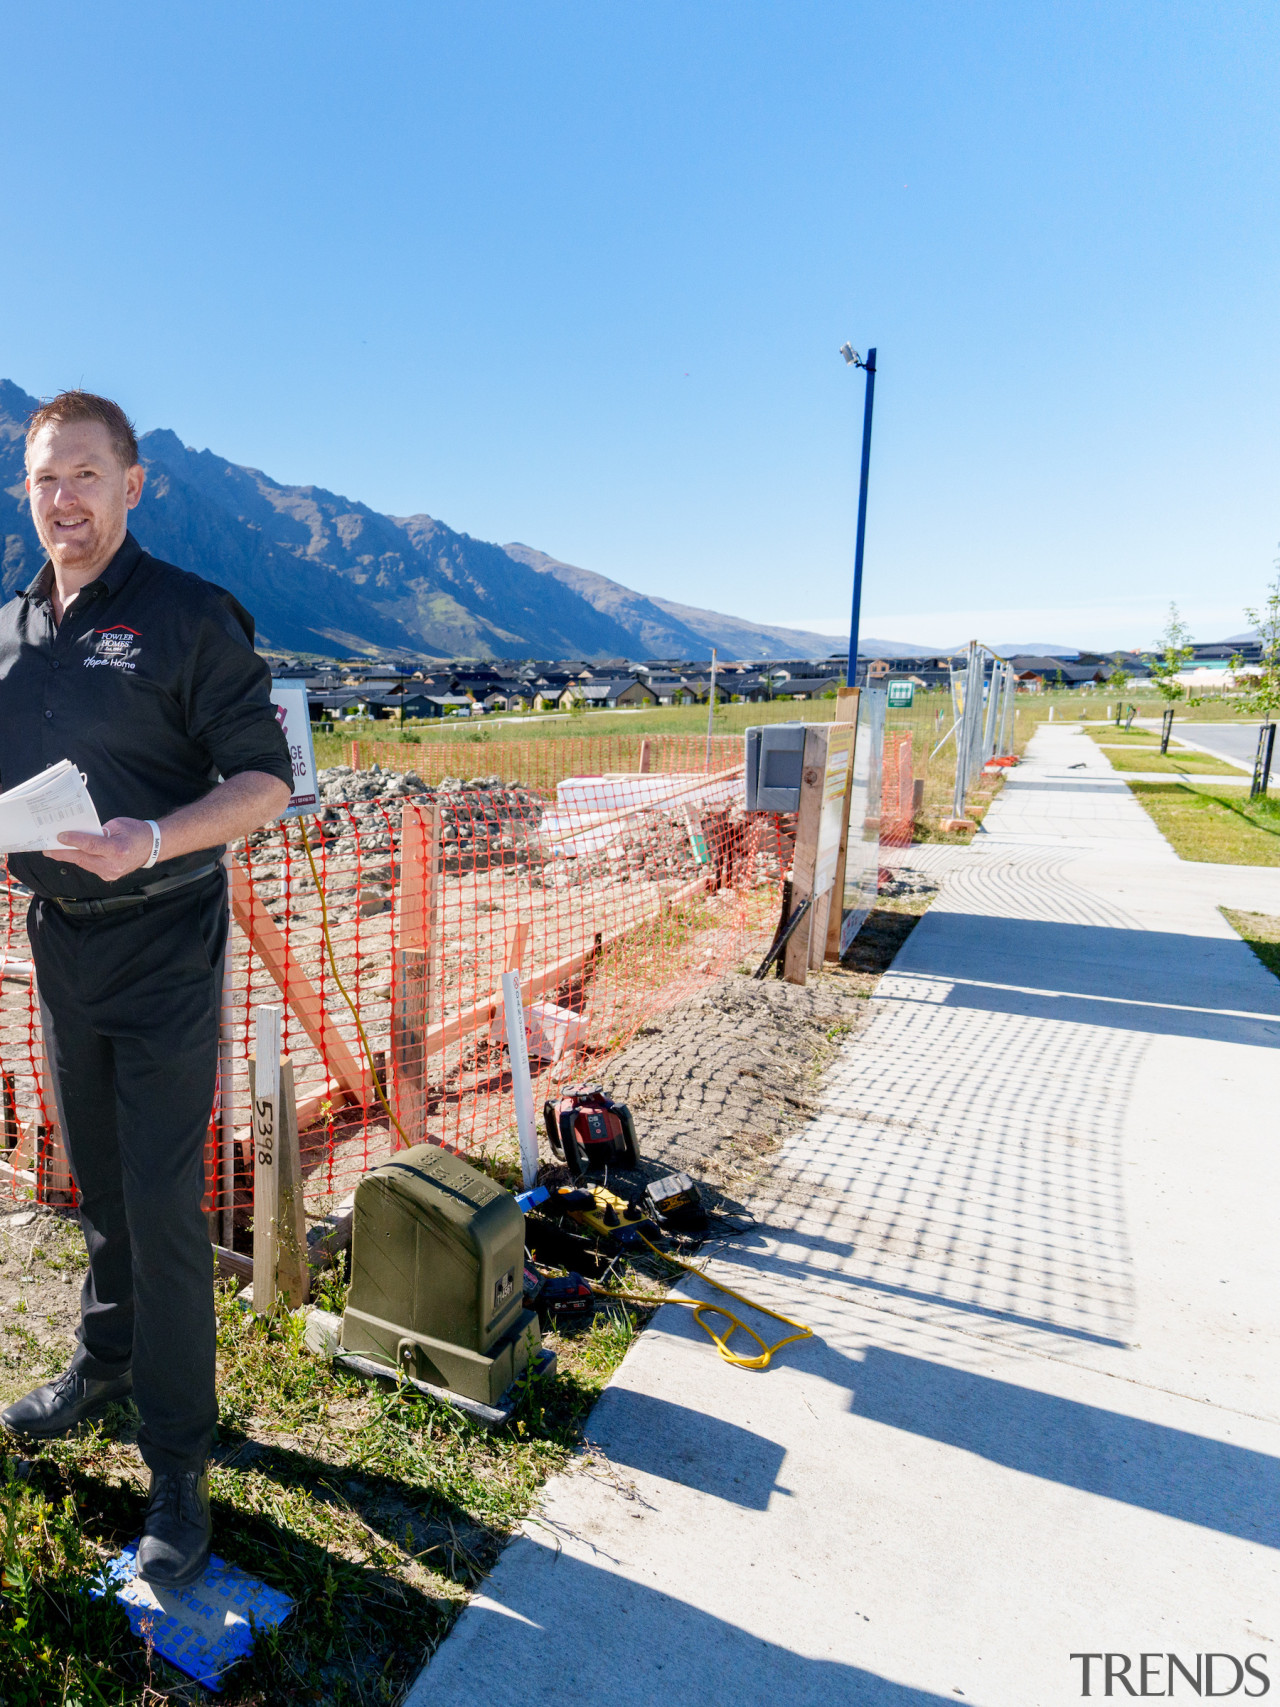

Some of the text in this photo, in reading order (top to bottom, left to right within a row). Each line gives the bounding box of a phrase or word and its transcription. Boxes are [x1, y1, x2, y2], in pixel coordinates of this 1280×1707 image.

[101, 633, 134, 641] FOWLER
[101, 640, 130, 648] HOMES
[83, 656, 136, 669] Hope Home
[290, 745, 303, 760] GE
[291, 761, 307, 777] RIC
[256, 1100, 274, 1166] 5398
